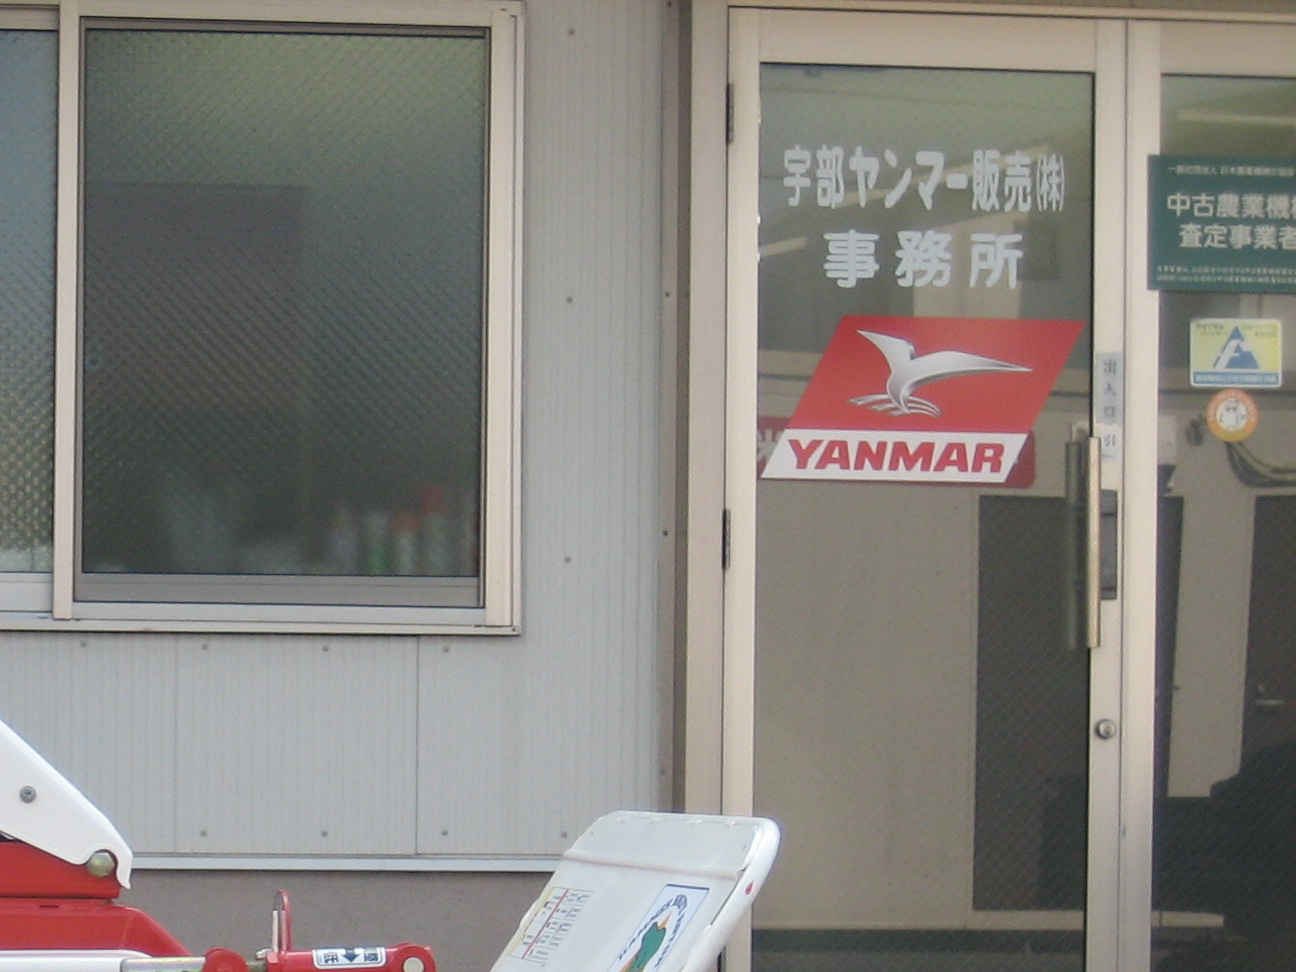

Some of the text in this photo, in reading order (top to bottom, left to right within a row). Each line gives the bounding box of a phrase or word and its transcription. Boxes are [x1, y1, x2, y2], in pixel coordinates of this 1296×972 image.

[823, 229, 1023, 289] 事務所
[788, 439, 1005, 473] YANMAR
